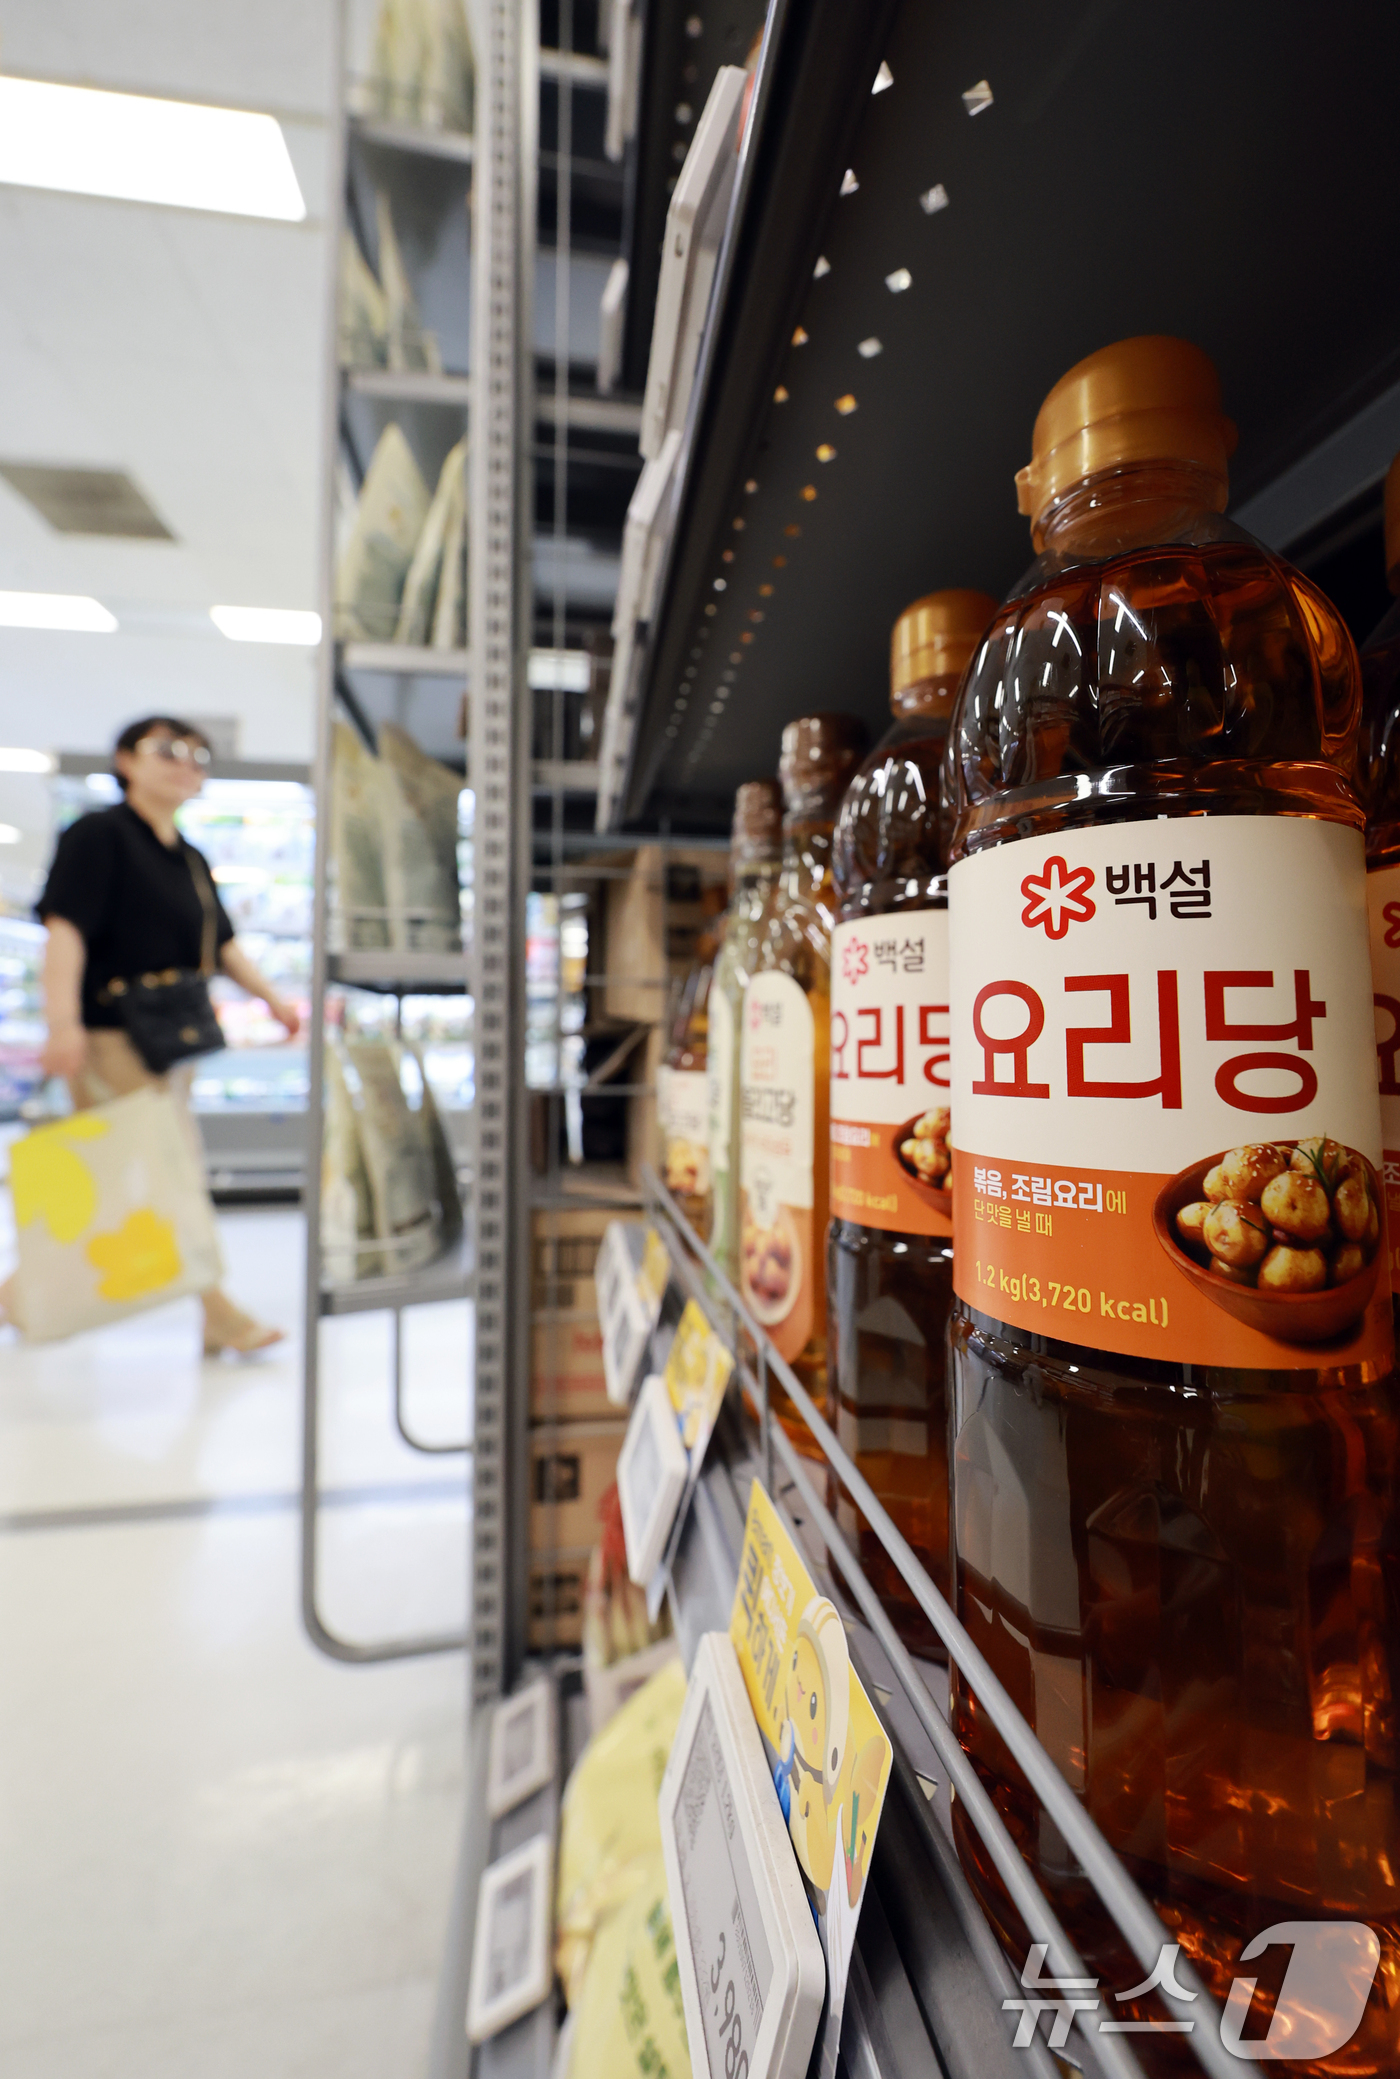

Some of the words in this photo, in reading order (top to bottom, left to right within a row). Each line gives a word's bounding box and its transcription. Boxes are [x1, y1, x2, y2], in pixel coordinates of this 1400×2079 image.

[1105, 858, 1212, 920] 백설
[873, 937, 925, 974] 백설
[971, 969, 1327, 1115] 요리당
[973, 1166, 1007, 1200] 볶음,
[1011, 1173, 1127, 1215] 조림요리에
[1016, 1209, 1031, 1233] 낼
[1035, 1212, 1053, 1237] 때
[1100, 1291, 1169, 1328] kcal)
